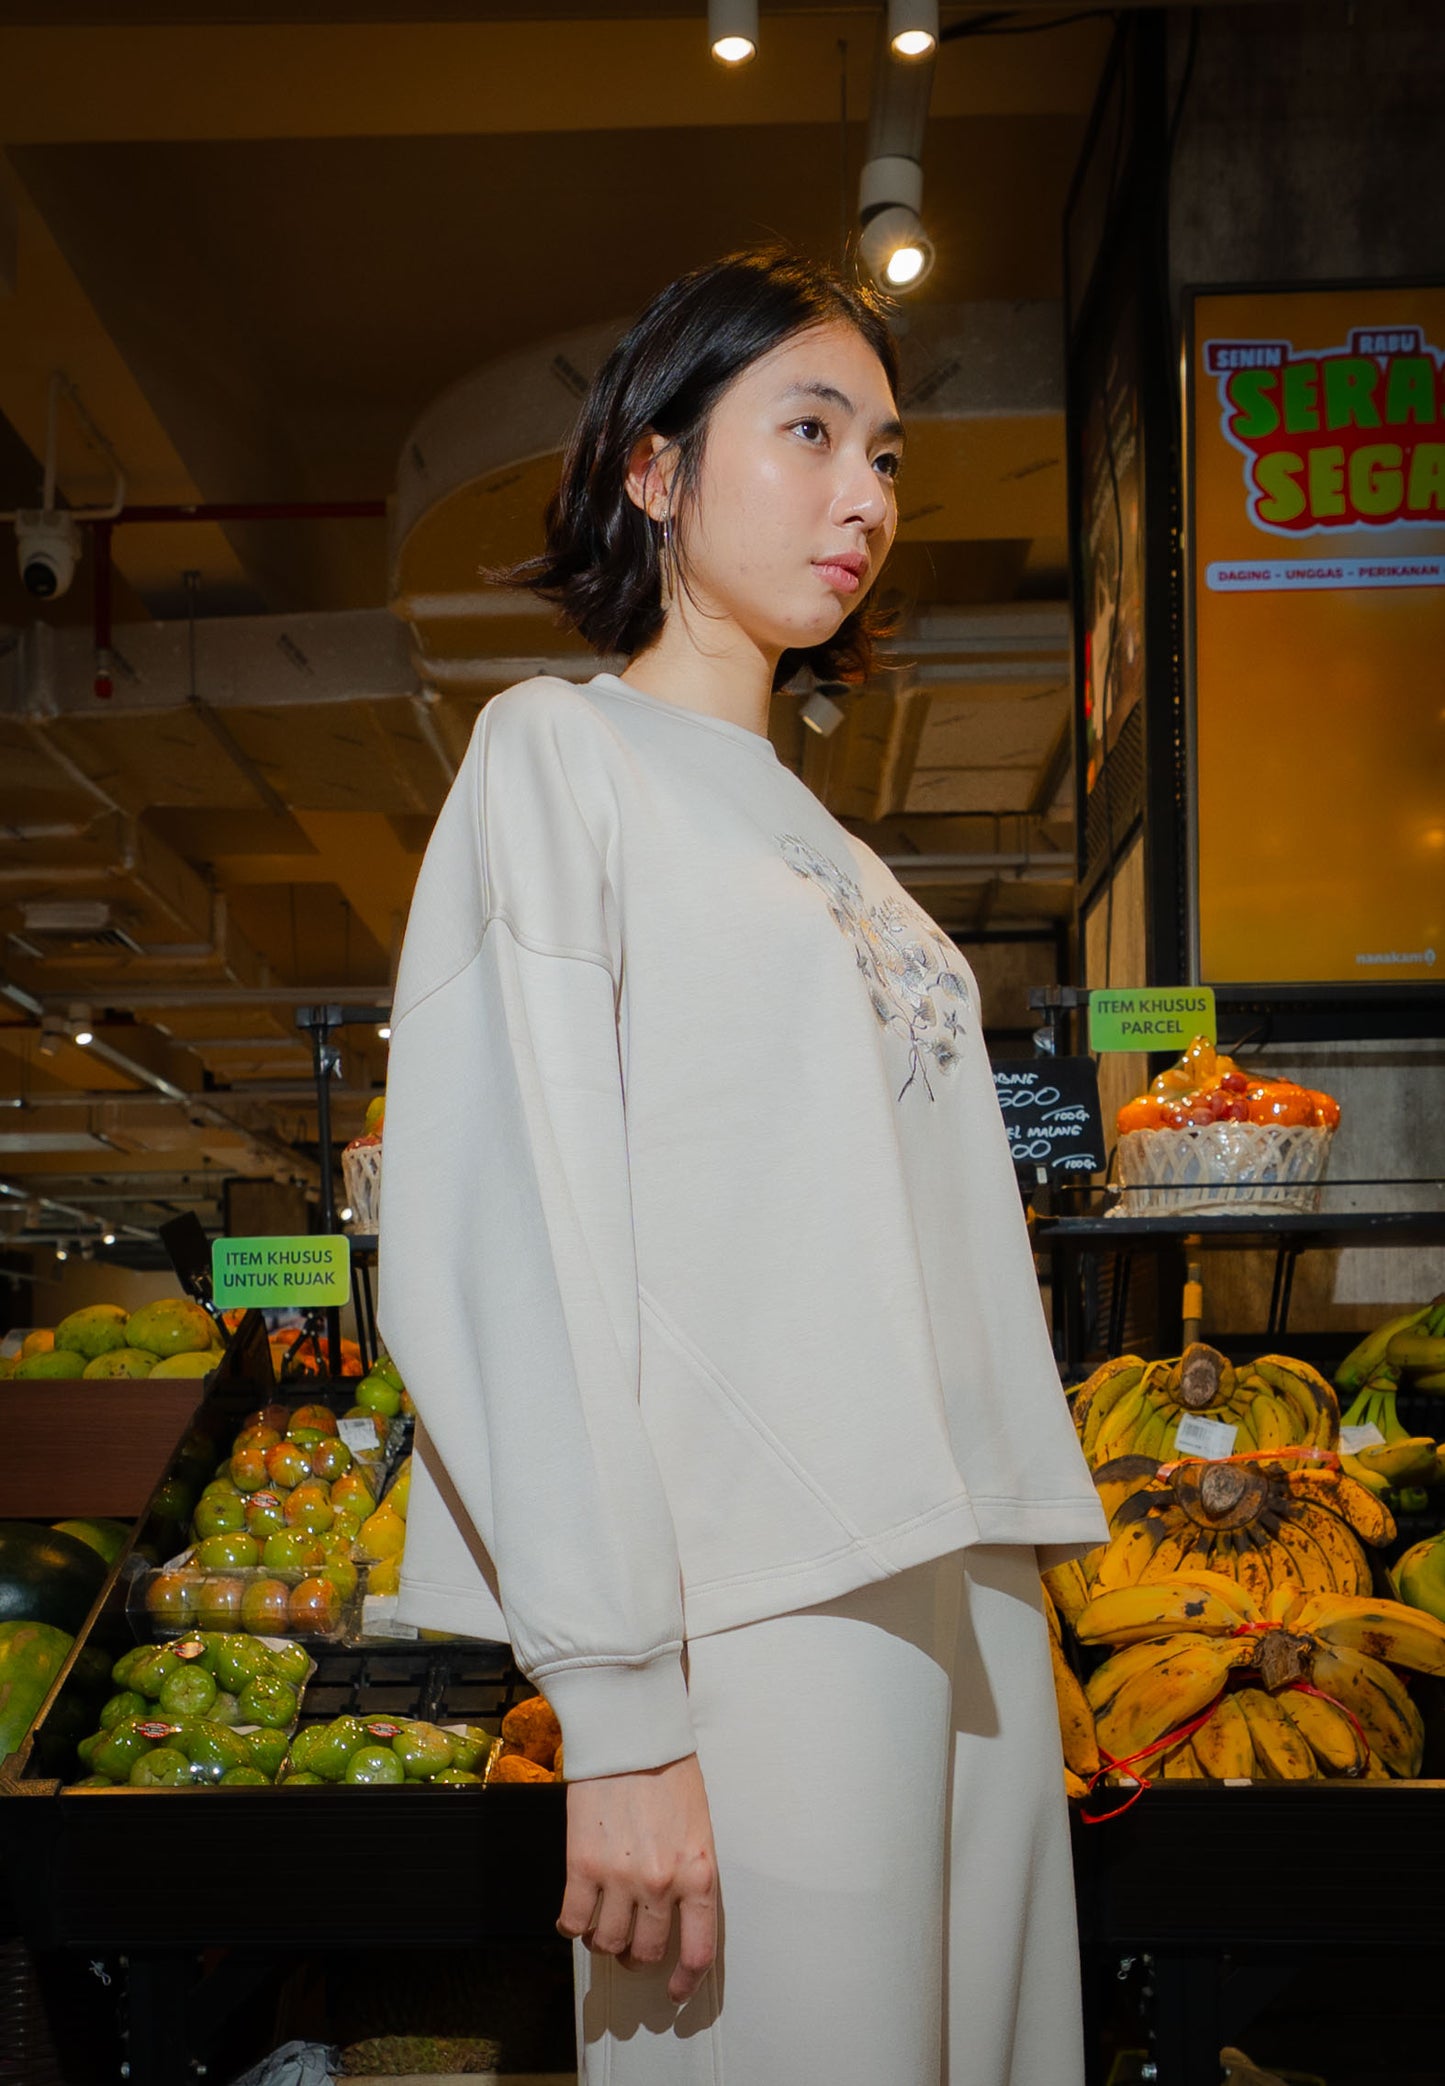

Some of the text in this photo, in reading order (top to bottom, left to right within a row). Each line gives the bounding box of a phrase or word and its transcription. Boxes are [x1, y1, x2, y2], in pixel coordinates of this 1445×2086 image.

[1360, 334, 1415, 353] RABU
[1216, 348, 1281, 369] SENIN
[1230, 357, 1445, 438] SERA
[1218, 570, 1271, 582] DAGING
[1285, 567, 1344, 580] UNGGAS
[1358, 564, 1440, 578] PERIKANAN
[1098, 997, 1207, 1015] ITEM KHUSUS
[1121, 1020, 1183, 1036] PARCEL
[226, 1250, 333, 1265] ITEM KHUSUS
[223, 1271, 336, 1288] UNTUK RUJAK
